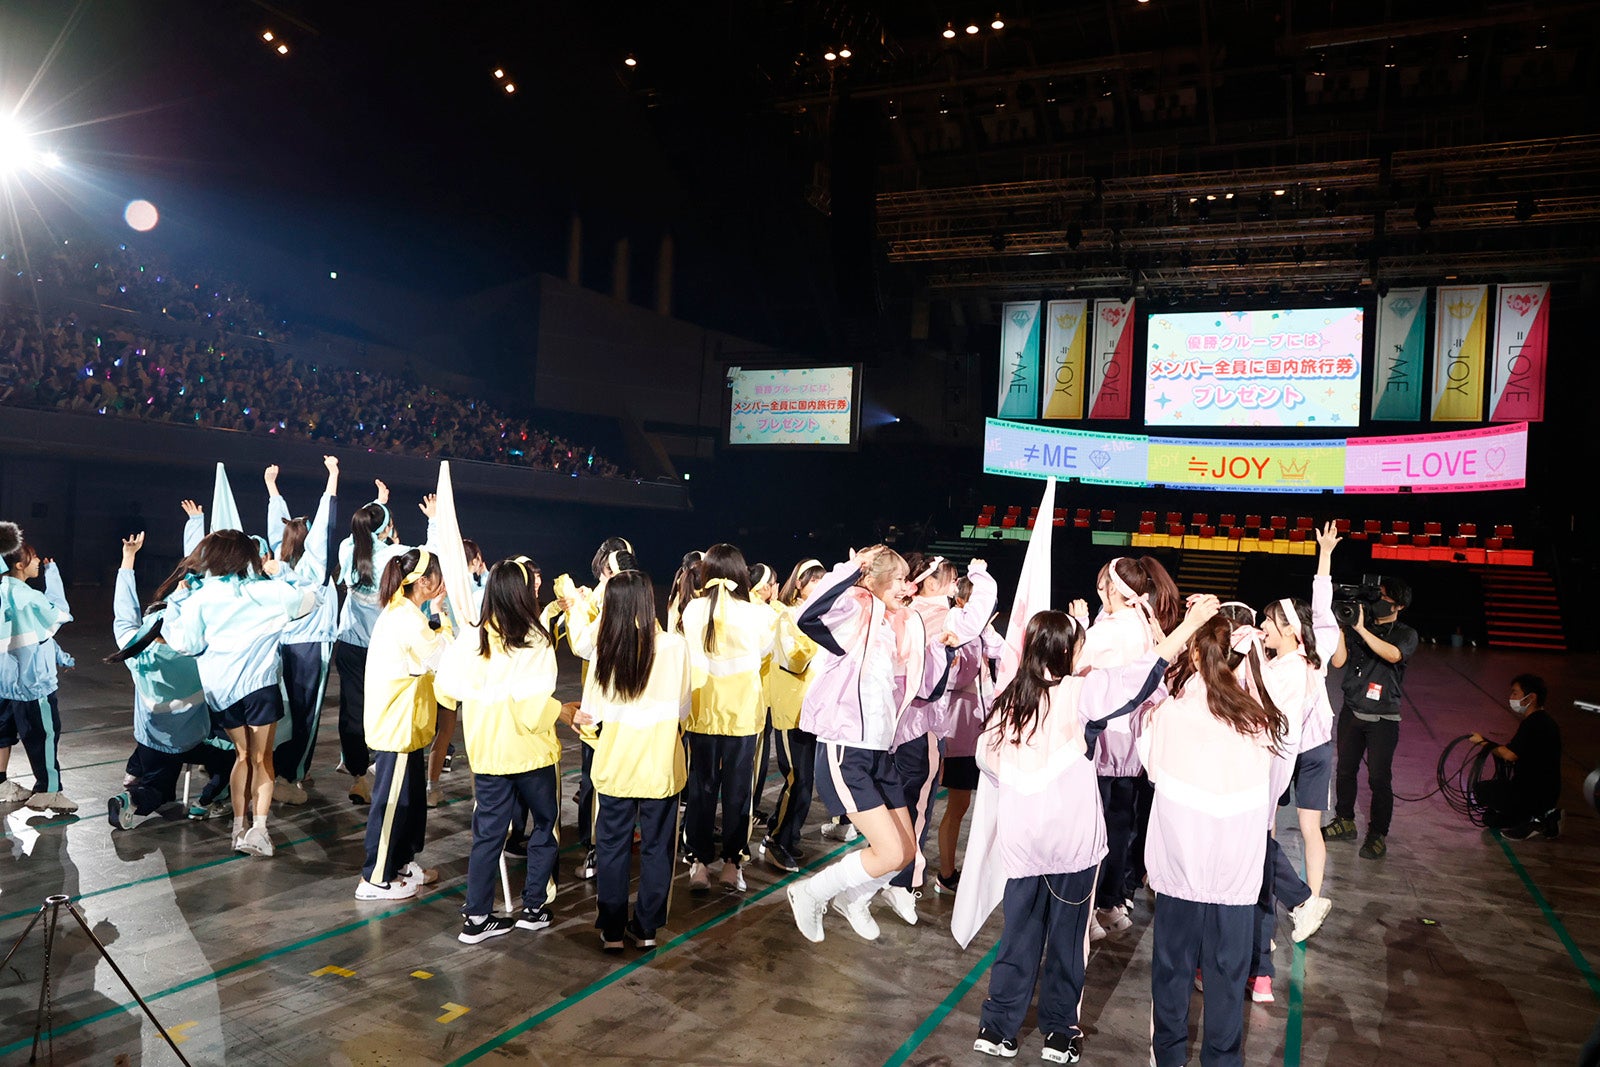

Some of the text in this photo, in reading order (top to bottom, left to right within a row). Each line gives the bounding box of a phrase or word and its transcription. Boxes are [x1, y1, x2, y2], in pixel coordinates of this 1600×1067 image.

[1187, 333, 1320, 350] 優勝グループには
[1150, 358, 1354, 375] メンバー全員に国内旅行券
[1194, 386, 1301, 404] プレゼント
[758, 418, 818, 430] プレゼント
